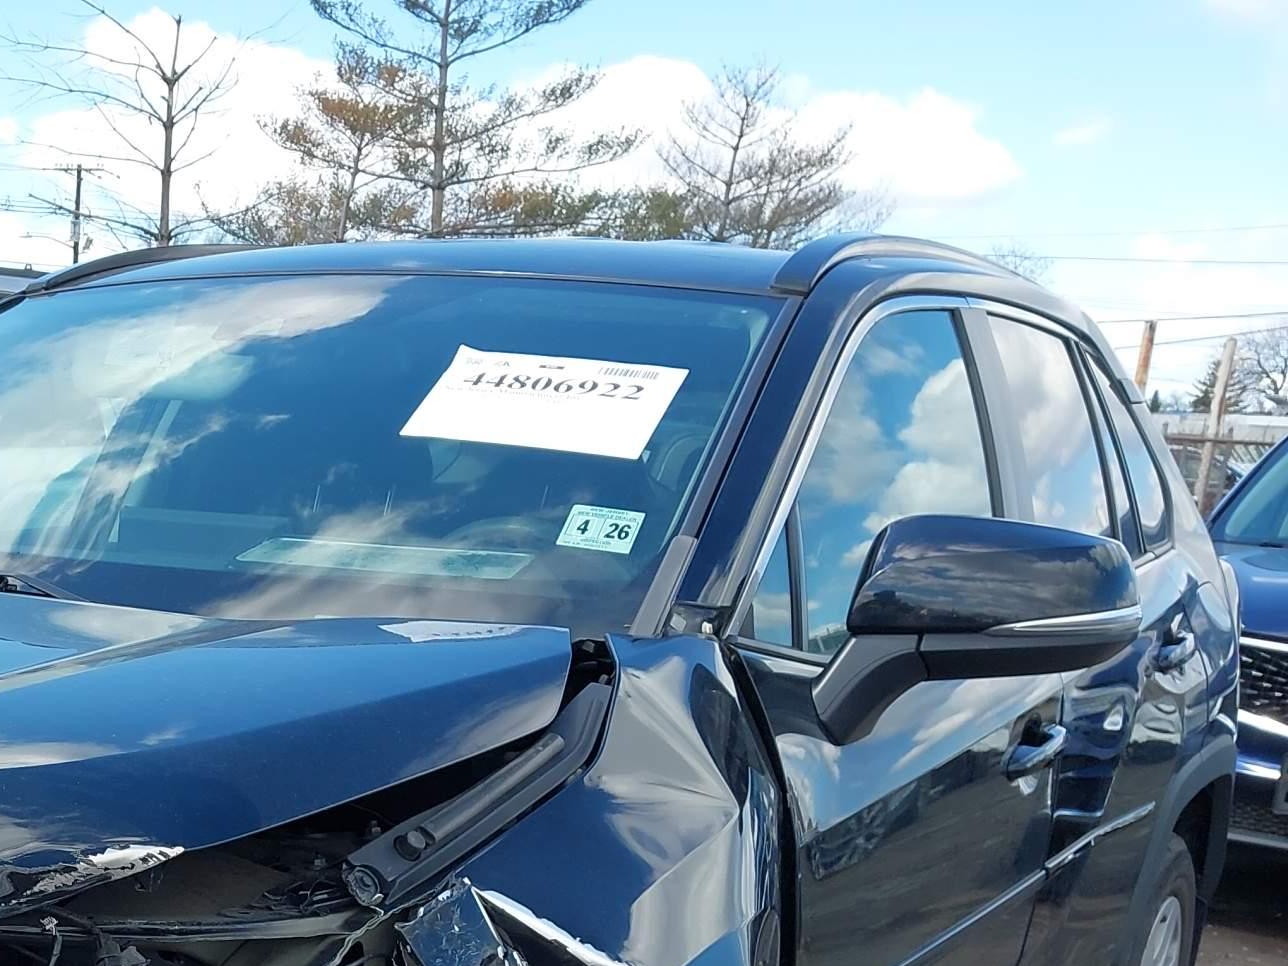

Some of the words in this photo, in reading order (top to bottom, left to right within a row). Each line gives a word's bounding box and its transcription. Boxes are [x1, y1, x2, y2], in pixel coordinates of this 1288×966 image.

[464, 372, 644, 400] 44806922
[576, 519, 591, 535] 4
[604, 523, 632, 540] 26
